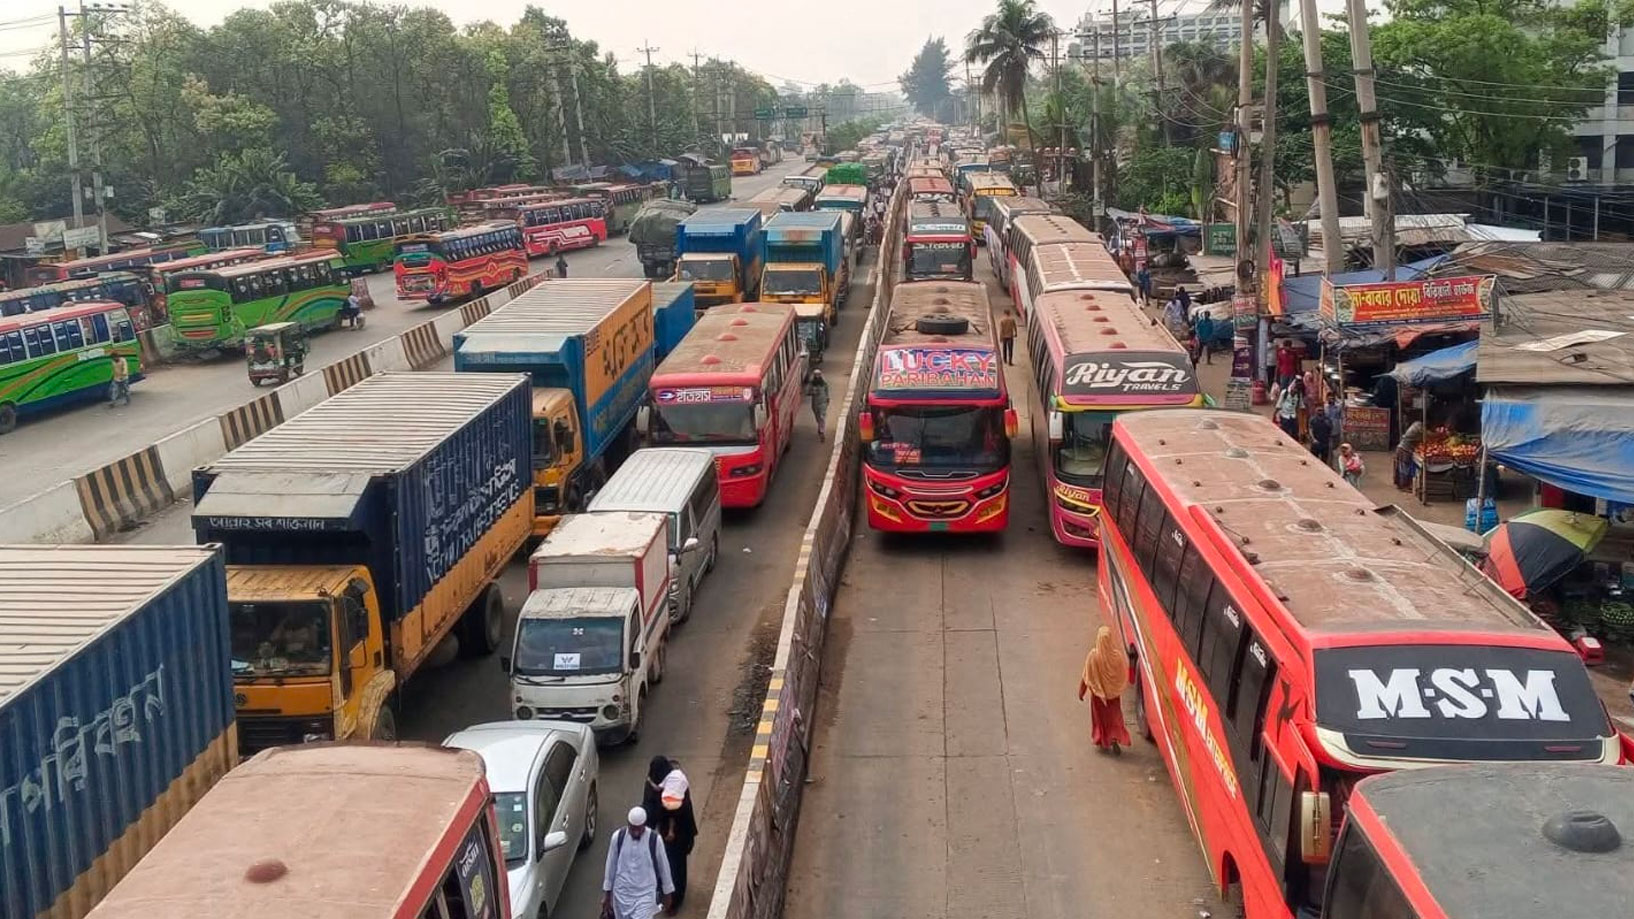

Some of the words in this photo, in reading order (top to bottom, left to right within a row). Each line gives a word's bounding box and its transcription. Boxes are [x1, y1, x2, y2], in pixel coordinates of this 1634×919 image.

[881, 350, 994, 374] LUCKY
[881, 372, 996, 386] PARIBAHAN
[1066, 361, 1191, 388] Riyan
[1122, 383, 1182, 391] TRAVELS
